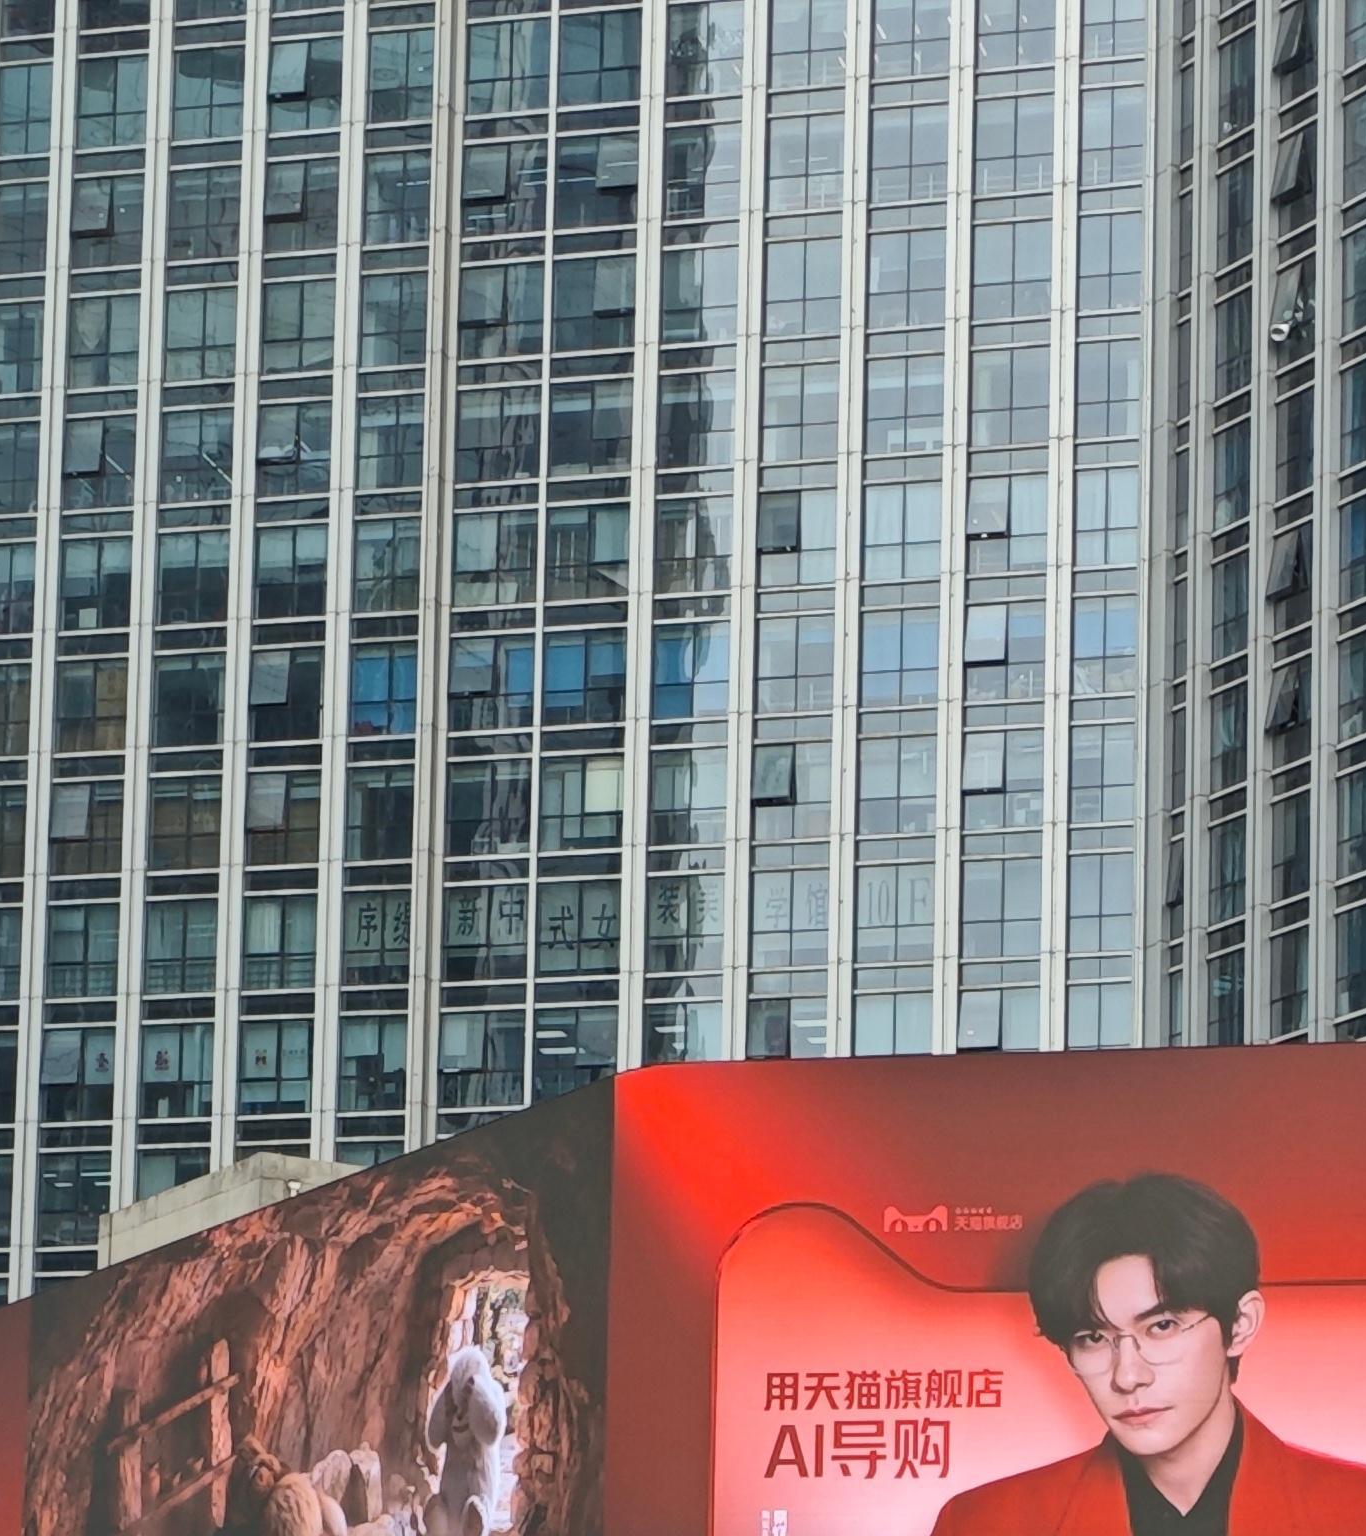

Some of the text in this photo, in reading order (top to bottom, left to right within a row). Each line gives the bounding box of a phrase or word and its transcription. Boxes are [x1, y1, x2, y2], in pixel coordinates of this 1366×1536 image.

[763, 1369, 1004, 1412] 用天猫旗舰店
[763, 1419, 951, 1480] AI导购
